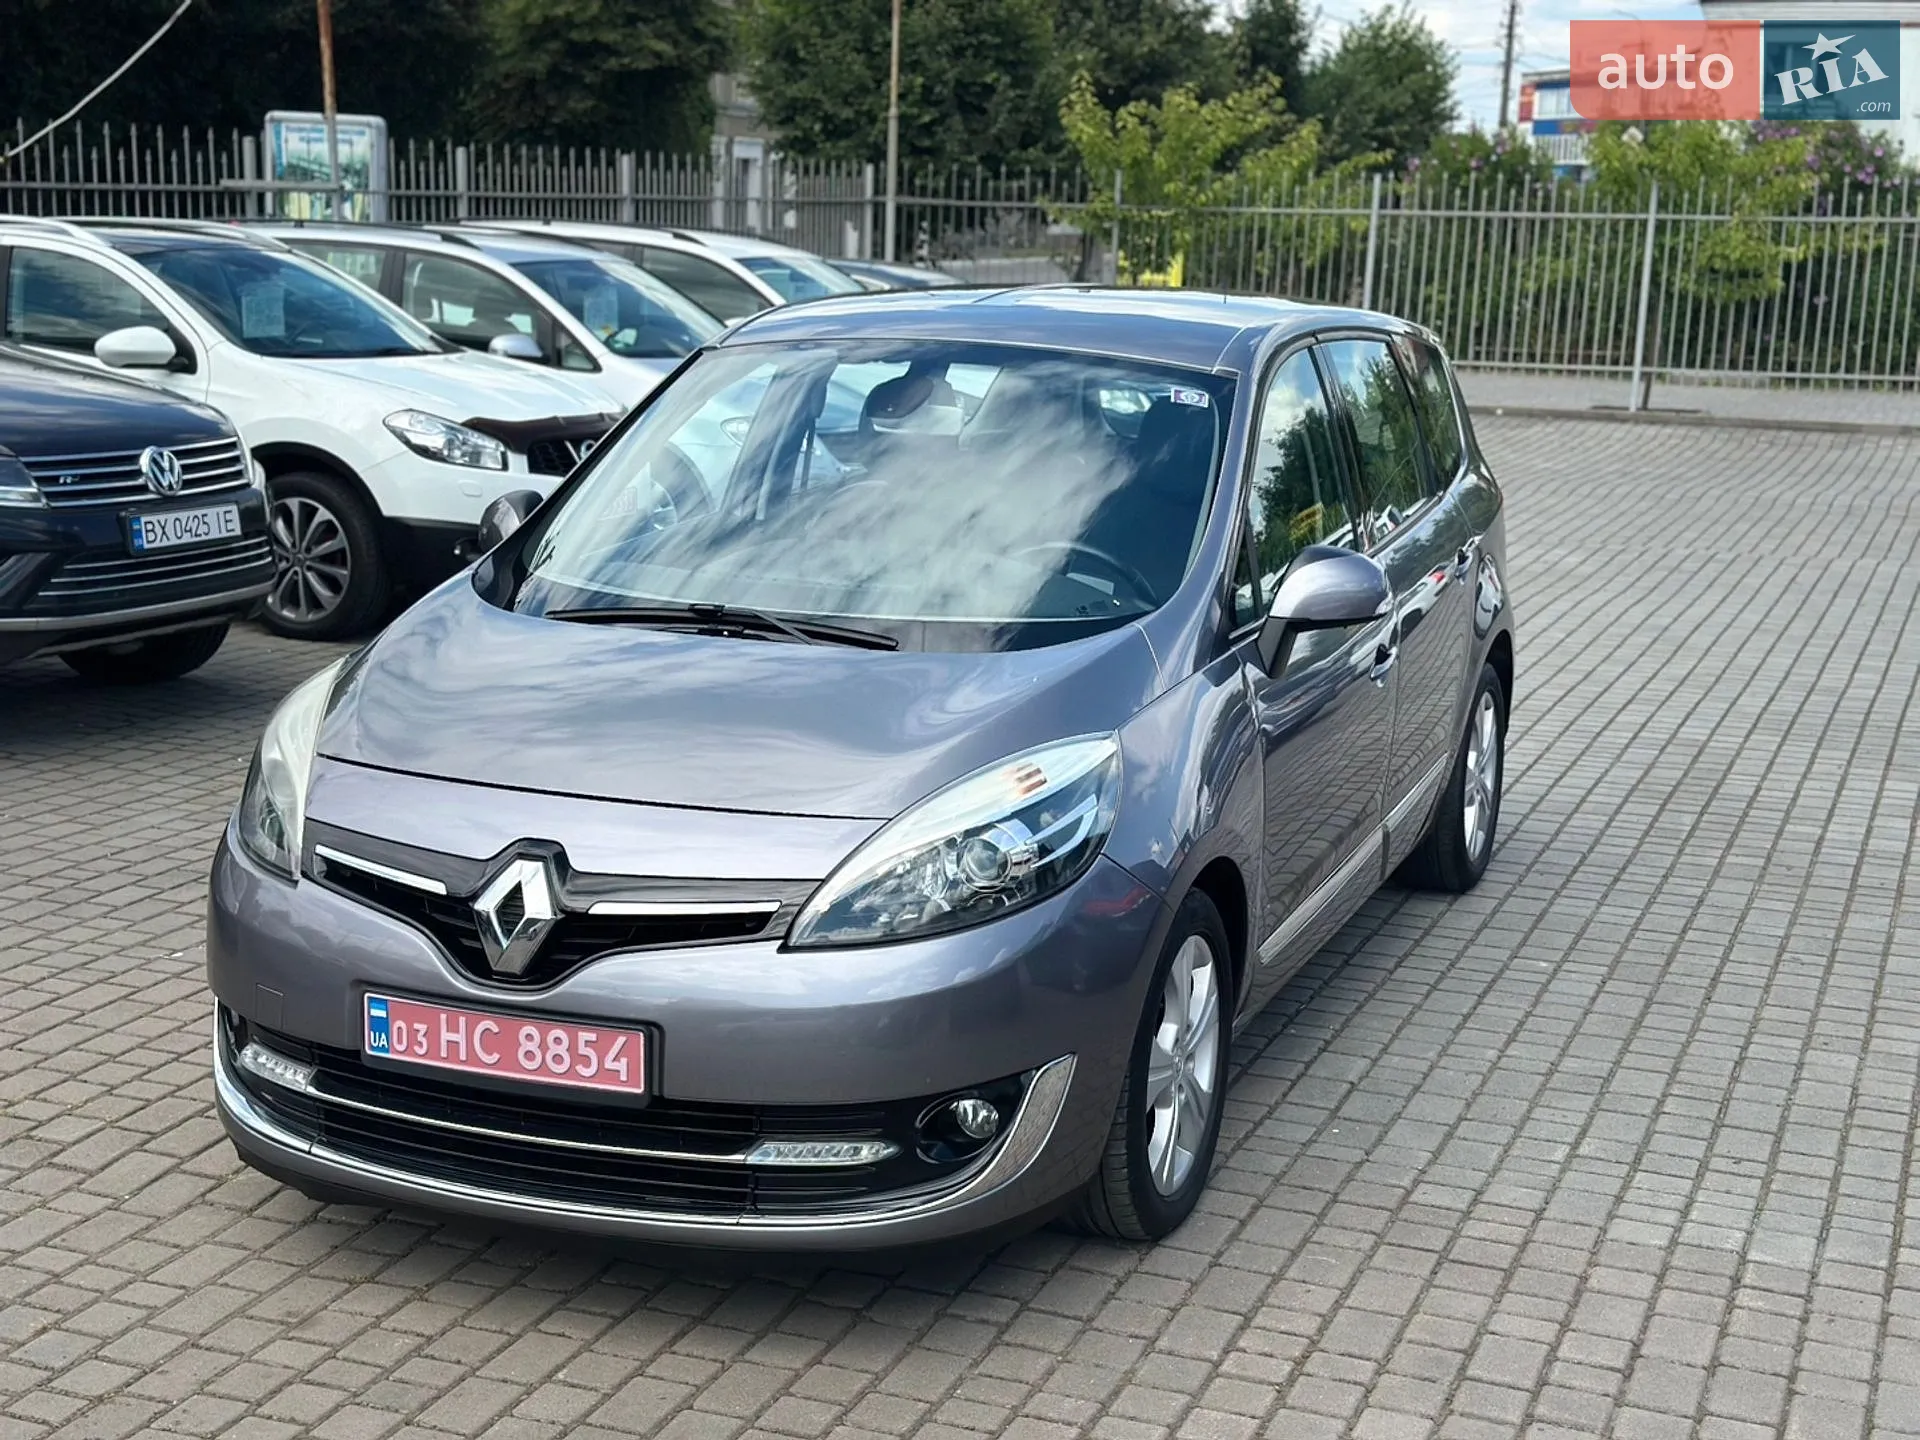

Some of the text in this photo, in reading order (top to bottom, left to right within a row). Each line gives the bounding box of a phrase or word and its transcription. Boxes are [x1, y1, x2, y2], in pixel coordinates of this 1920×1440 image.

[144, 518, 170, 544] BX
[173, 513, 211, 540] 0425
[216, 509, 235, 534] IE
[370, 1030, 389, 1049] UA
[392, 1013, 628, 1082] 03 HC 8854
